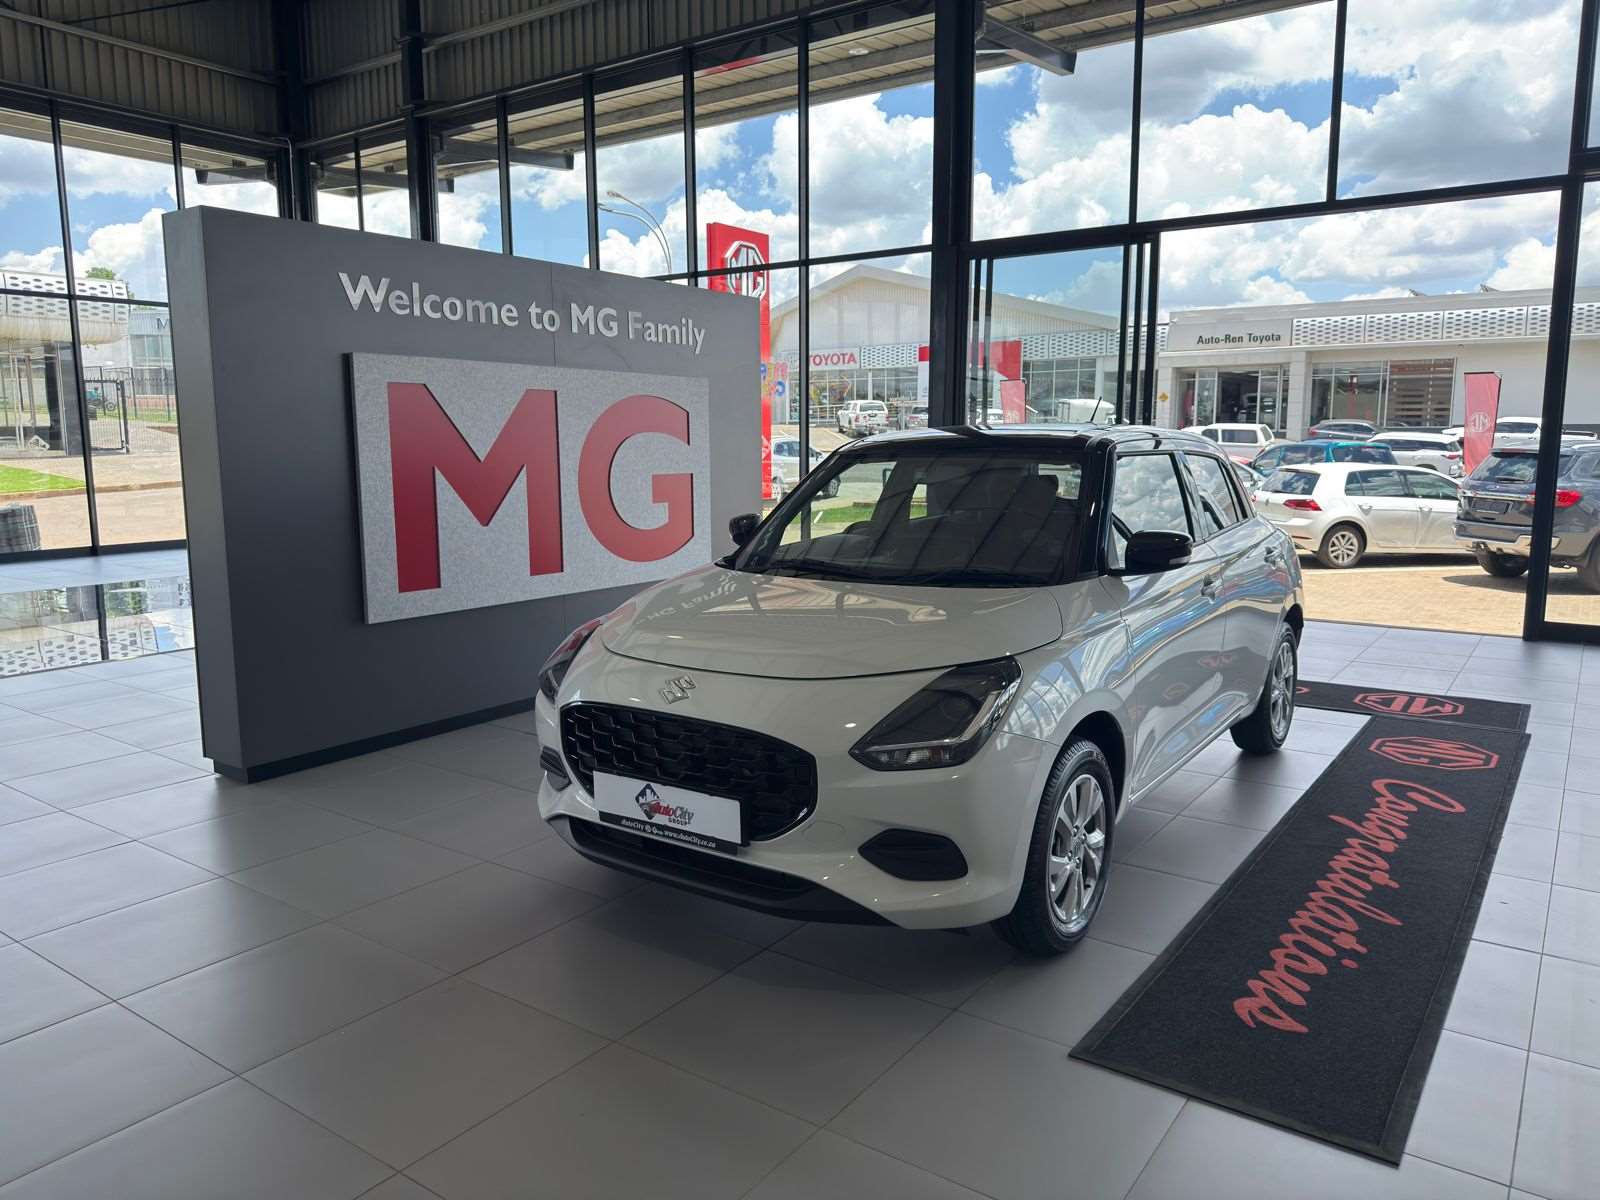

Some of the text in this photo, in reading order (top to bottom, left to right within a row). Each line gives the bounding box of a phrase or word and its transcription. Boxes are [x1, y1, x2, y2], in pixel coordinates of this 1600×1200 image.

[338, 271, 705, 354] Welcome to MG Family
[1196, 332, 1281, 345] Auto-Ren Toyota
[387, 382, 694, 593] MG
[1233, 778, 1466, 1034] Congratulations
